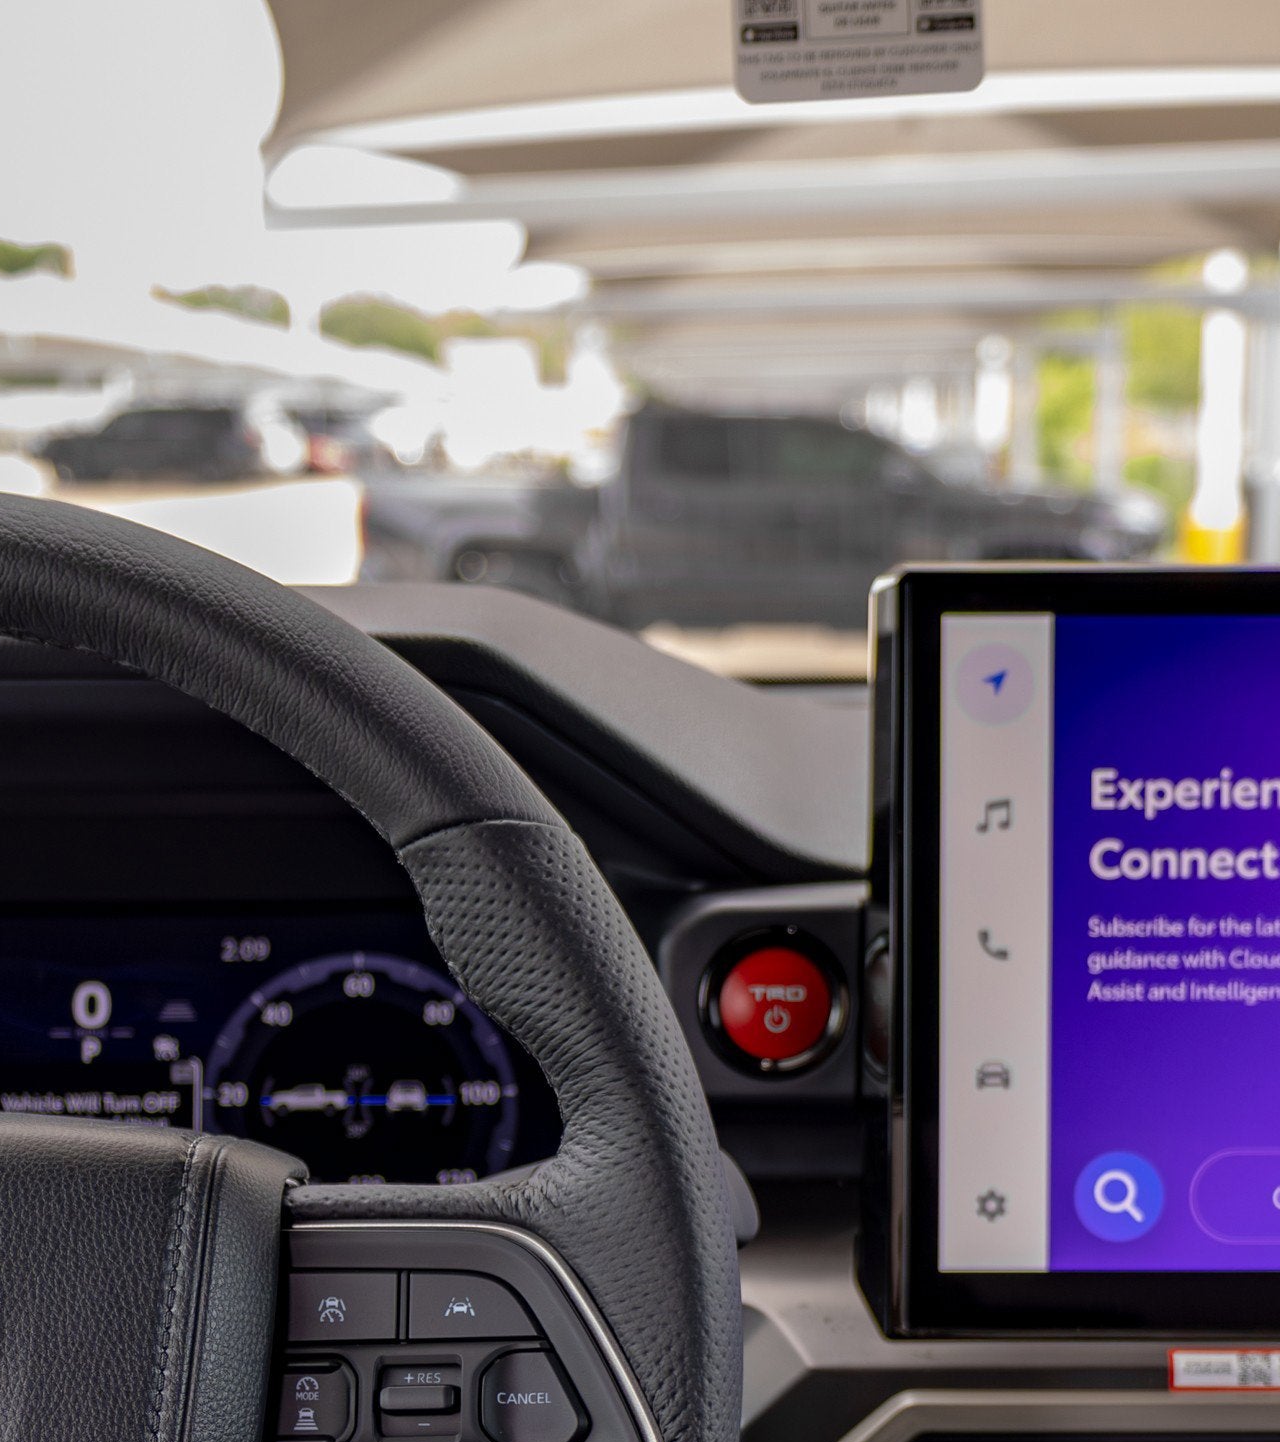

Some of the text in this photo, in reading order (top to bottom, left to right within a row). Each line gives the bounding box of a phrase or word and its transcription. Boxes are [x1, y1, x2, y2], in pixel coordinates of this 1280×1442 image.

[1088, 837, 1280, 880] Connect
[1087, 916, 1184, 938] Subscribe
[1187, 916, 1217, 937] for
[1219, 916, 1253, 937] the
[1086, 948, 1180, 974] guidance
[1182, 948, 1225, 969] with
[748, 984, 808, 1003] TRD
[1087, 980, 1144, 1001] Assist
[1148, 980, 1186, 1001] and
[72, 980, 112, 1029] 0
[81, 1035, 102, 1064] P
[142, 1091, 181, 1114] OFF
[295, 1391, 320, 1402] MODE
[496, 1391, 552, 1406] CANCEL
